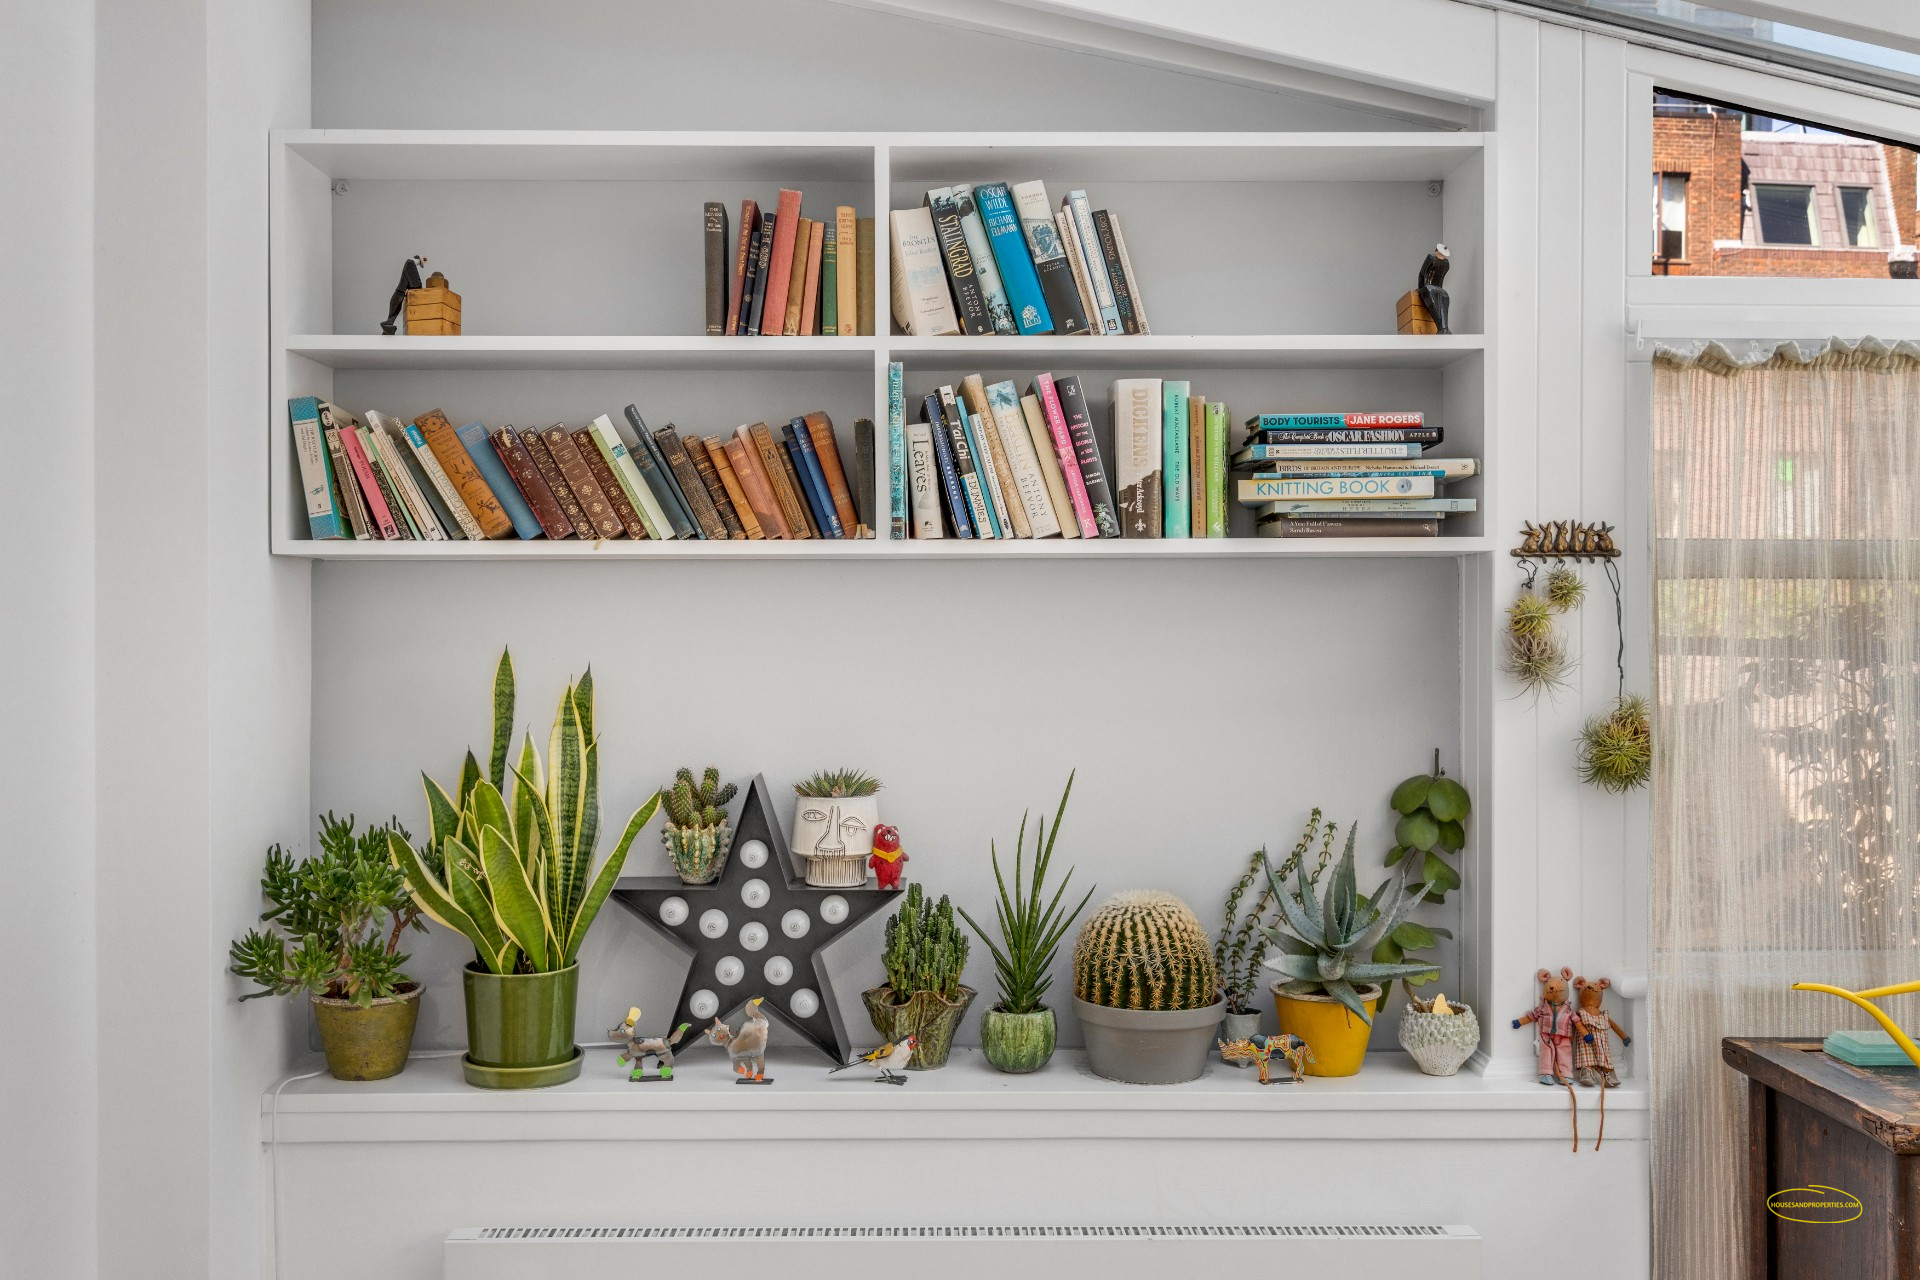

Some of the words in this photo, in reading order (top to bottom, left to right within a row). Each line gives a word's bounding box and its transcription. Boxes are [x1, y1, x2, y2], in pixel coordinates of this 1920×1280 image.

[980, 186, 1006, 199] OSCAR
[985, 198, 1008, 210] WILDE
[989, 214, 1014, 228] RICHARD
[991, 224, 1017, 236] ELLMANN
[1097, 213, 1109, 233] TOBY
[938, 213, 974, 279] STALINGRAD
[1102, 231, 1116, 260] YOUNG
[968, 283, 983, 317] ANTONY
[1043, 380, 1052, 395] THE
[1048, 396, 1061, 424] FLOWER
[1056, 426, 1067, 445] YARD
[1293, 417, 1339, 425] TOURISTS
[1350, 416, 1377, 424] JANE
[1379, 415, 1420, 423] ROGERS
[1132, 387, 1149, 467] DICKENS
[1328, 431, 1362, 442] OSCAR
[1363, 430, 1404, 441] FASHION
[956, 440, 971, 461] Chi
[1004, 412, 1036, 471] BERLIN
[420, 447, 442, 475] Poems
[912, 440, 930, 492] Leaves
[437, 474, 464, 510] Collected
[1020, 477, 1039, 518] BEEVOR
[1028, 472, 1047, 517] ANTONY
[1135, 487, 1144, 512] Ackroyd
[1257, 481, 1333, 495] KNITTING
[1340, 480, 1390, 494] BOOK
[967, 480, 988, 524] DUMMIES
